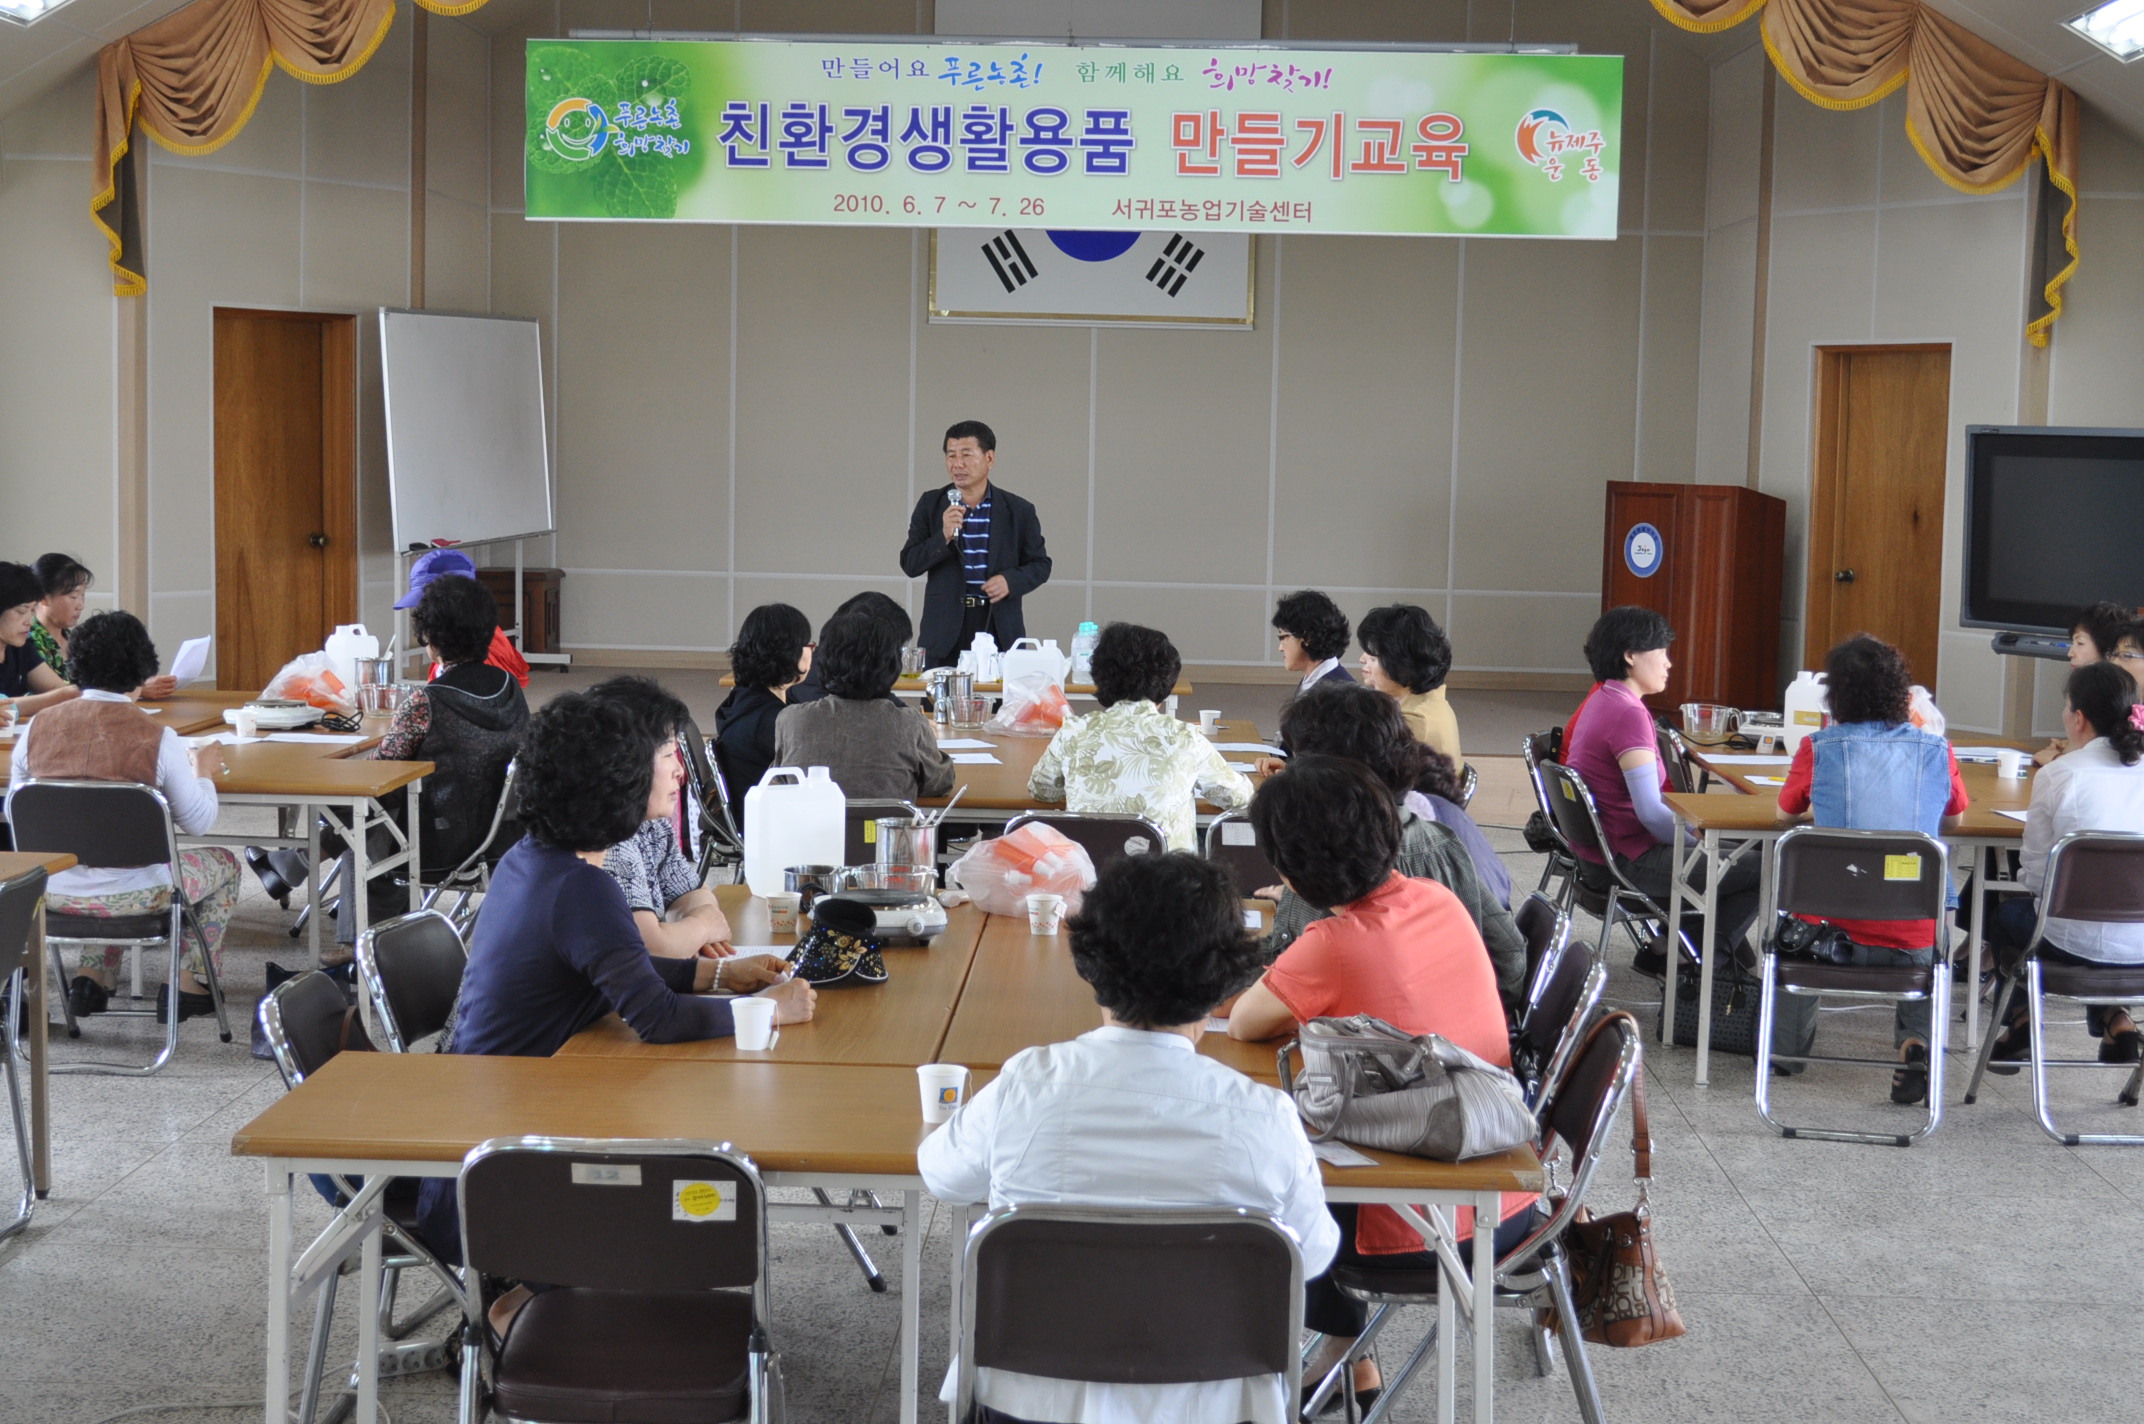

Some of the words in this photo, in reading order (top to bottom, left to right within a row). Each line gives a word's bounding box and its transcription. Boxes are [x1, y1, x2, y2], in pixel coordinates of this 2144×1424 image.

[821, 56, 930, 80] 만들어요
[1075, 61, 1185, 84] 함께해요
[718, 100, 1136, 175] 친환경생활용품
[1170, 108, 1469, 183] 만들기교육
[833, 193, 890, 215] 2010.
[1019, 197, 1045, 216] 26
[1111, 197, 1313, 224] 서귀포농업기술센터
